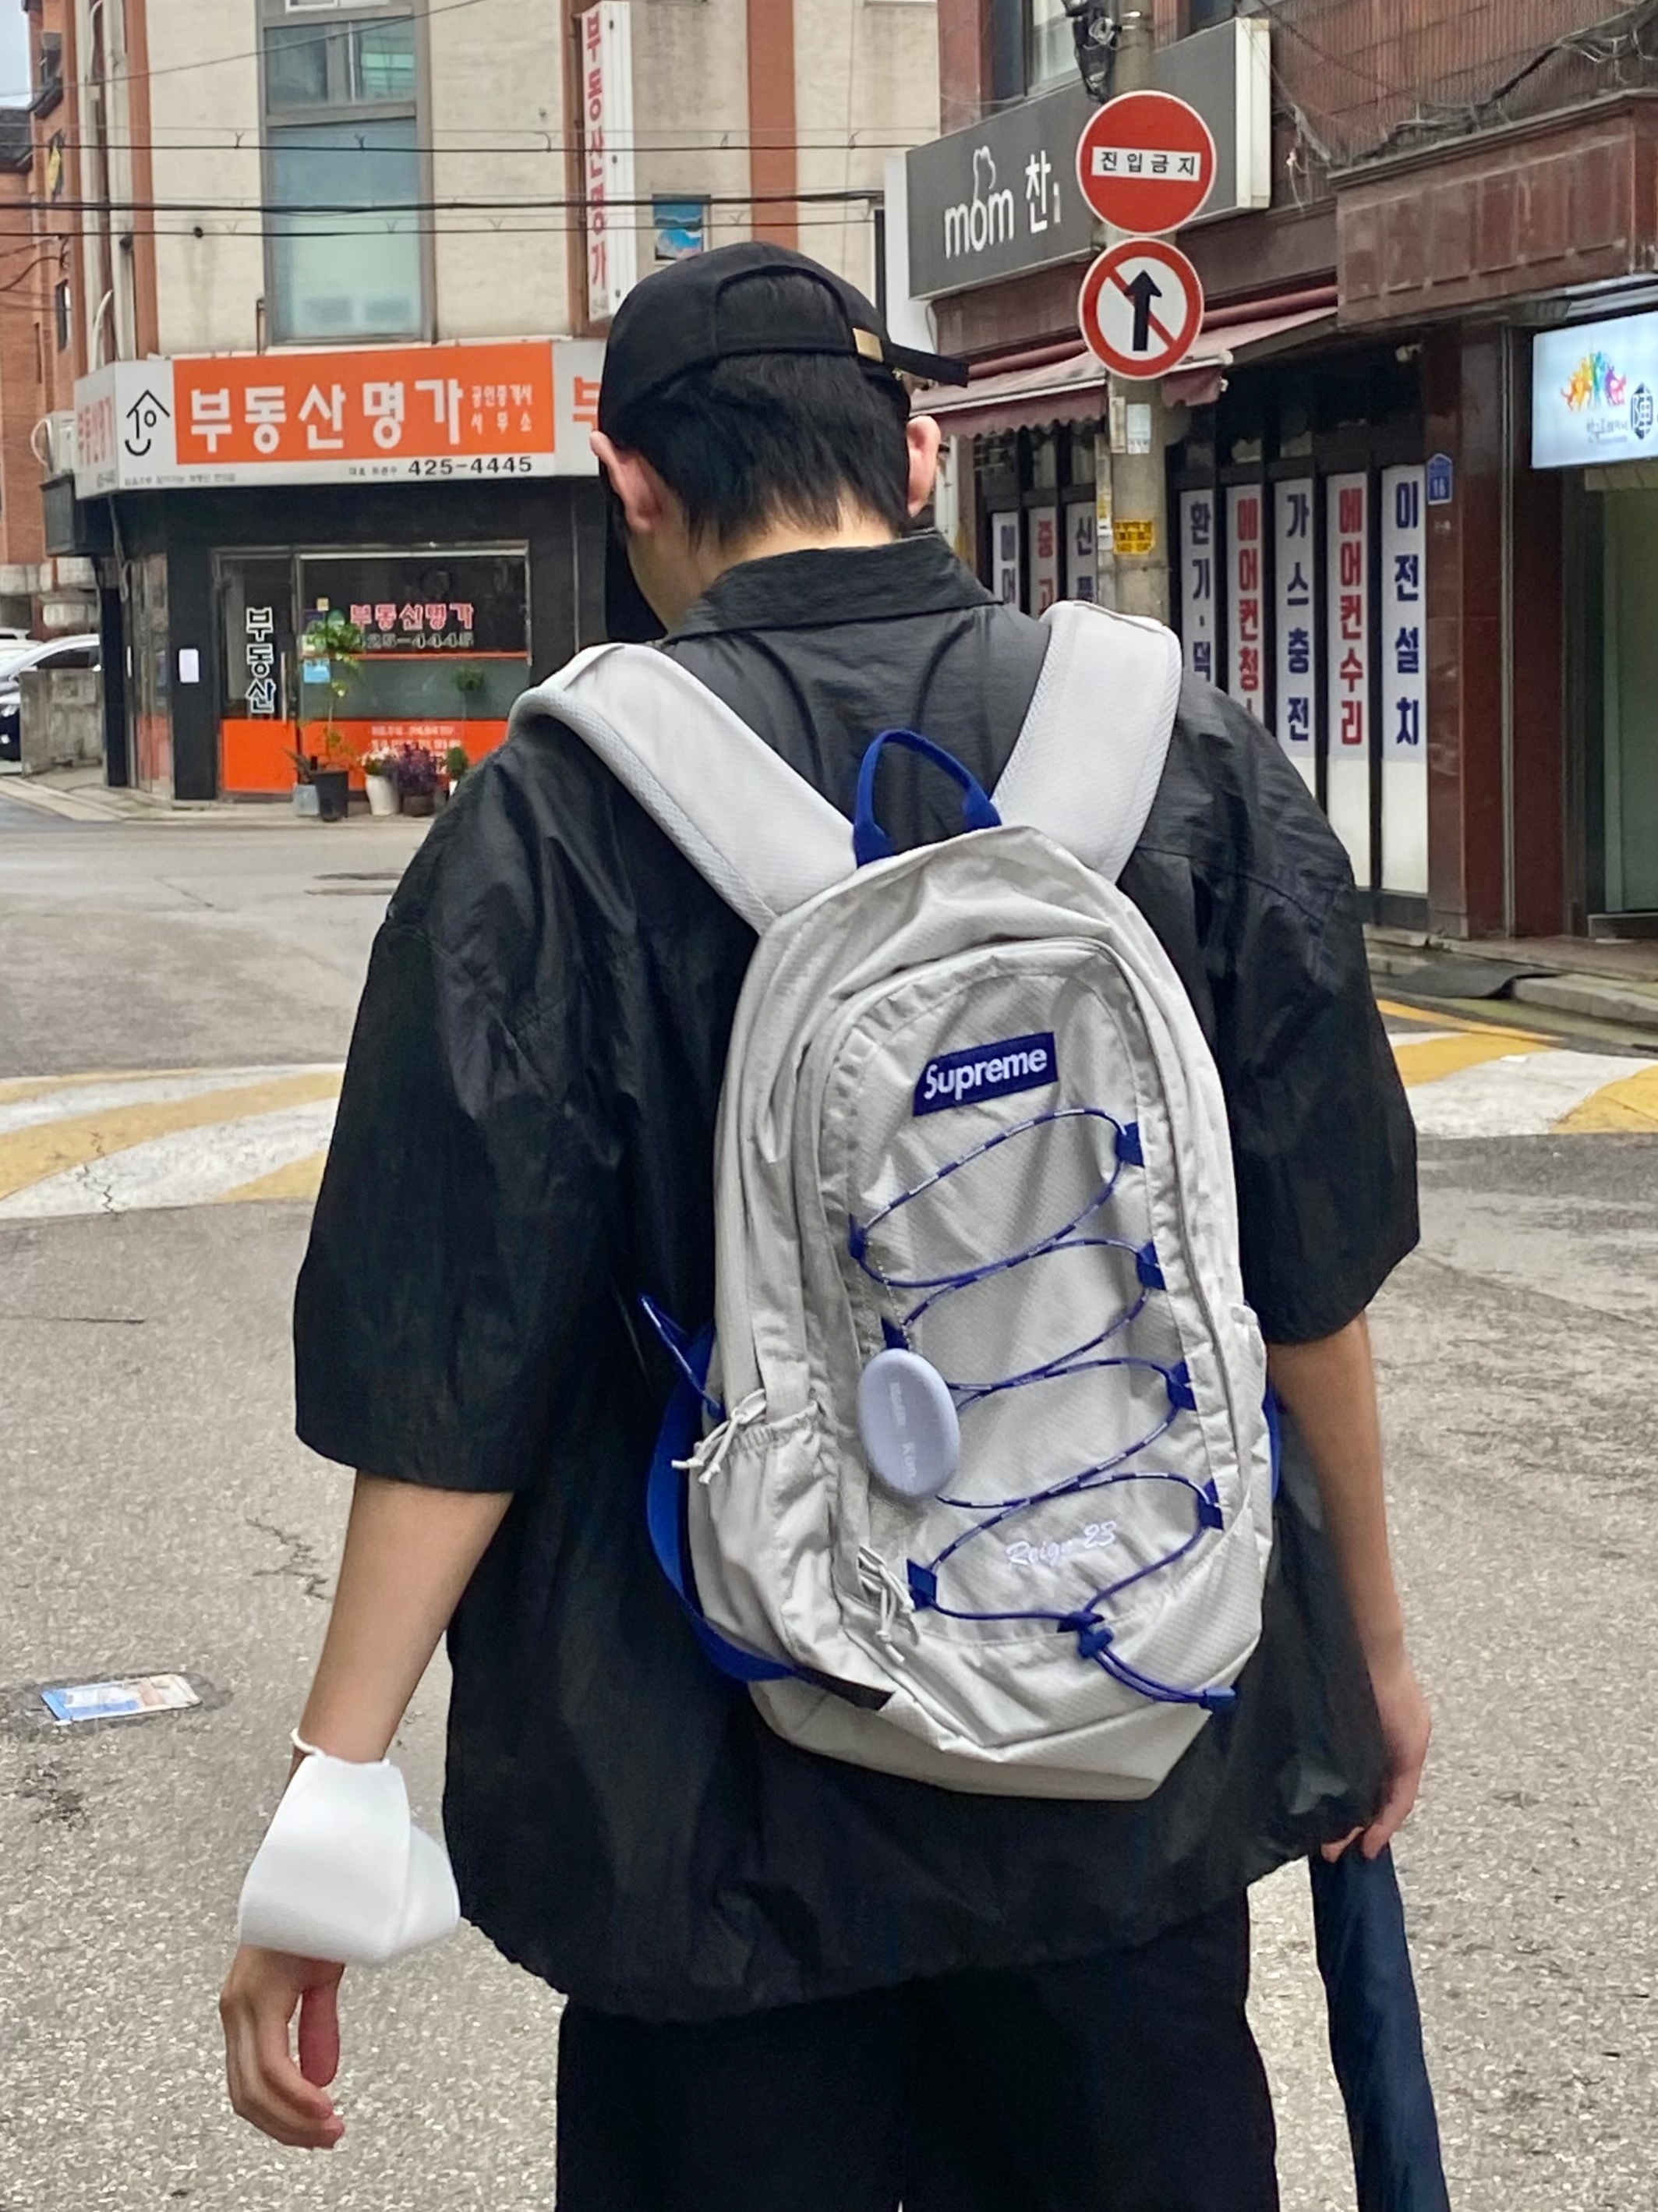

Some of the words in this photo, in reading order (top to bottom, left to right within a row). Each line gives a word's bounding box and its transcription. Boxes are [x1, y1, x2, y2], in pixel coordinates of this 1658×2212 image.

[586, 10, 606, 291] 부동산명가
[1101, 150, 1196, 176] 진입금지
[945, 188, 1014, 259] mom
[190, 378, 463, 453] 부동산명가
[408, 456, 532, 476] 425-4445
[1237, 497, 1259, 713] 에어컨청
[1285, 493, 1310, 742] 가스충전
[1338, 487, 1364, 746] 에어컨수리
[1394, 480, 1419, 746] 이전설치
[245, 606, 277, 714] 부동산
[923, 1048, 1048, 1101] Supreme
